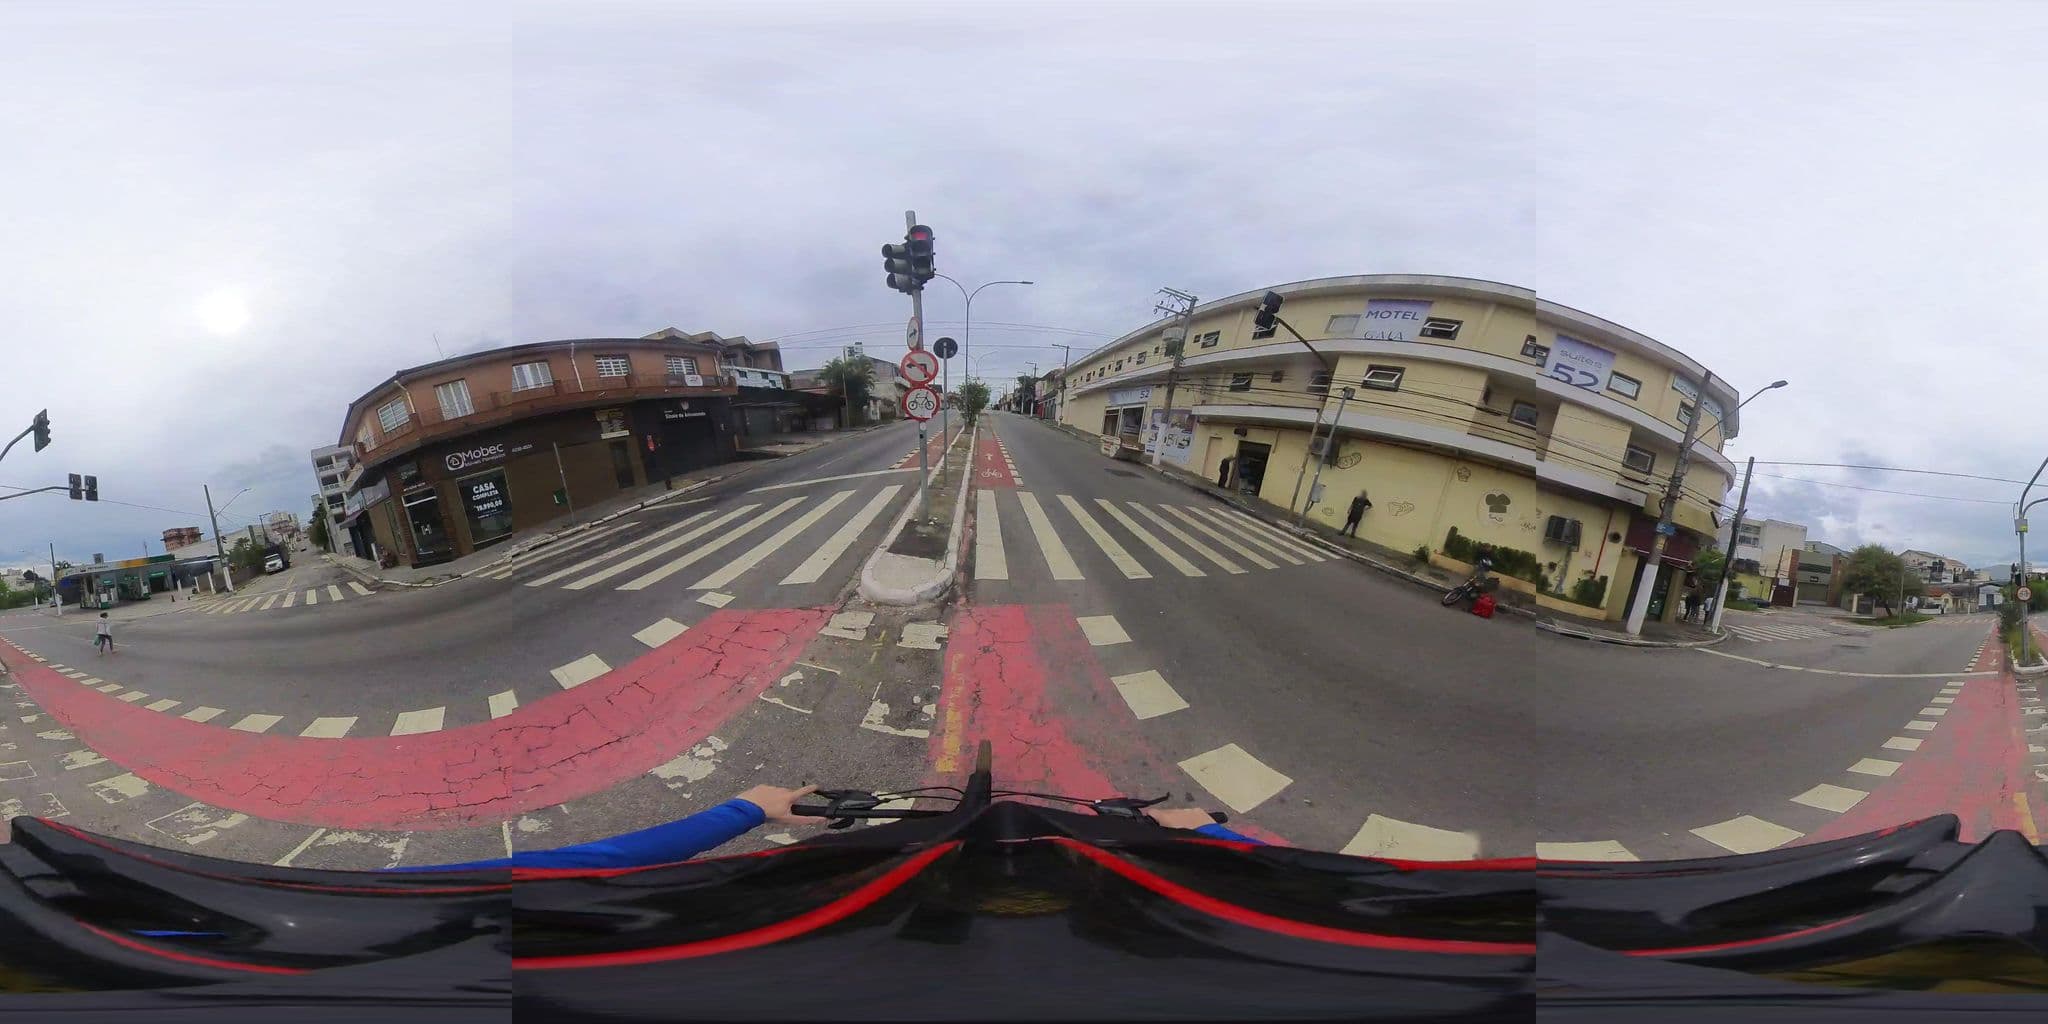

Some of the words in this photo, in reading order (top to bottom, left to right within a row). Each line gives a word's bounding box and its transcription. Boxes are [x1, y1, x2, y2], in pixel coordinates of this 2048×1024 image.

[1365, 310, 1420, 321] MOTEL
[1553, 362, 1599, 388] 52
[461, 443, 504, 461] Mobec
[473, 481, 495, 493] CASA
[472, 490, 499, 500] COMPLETA
